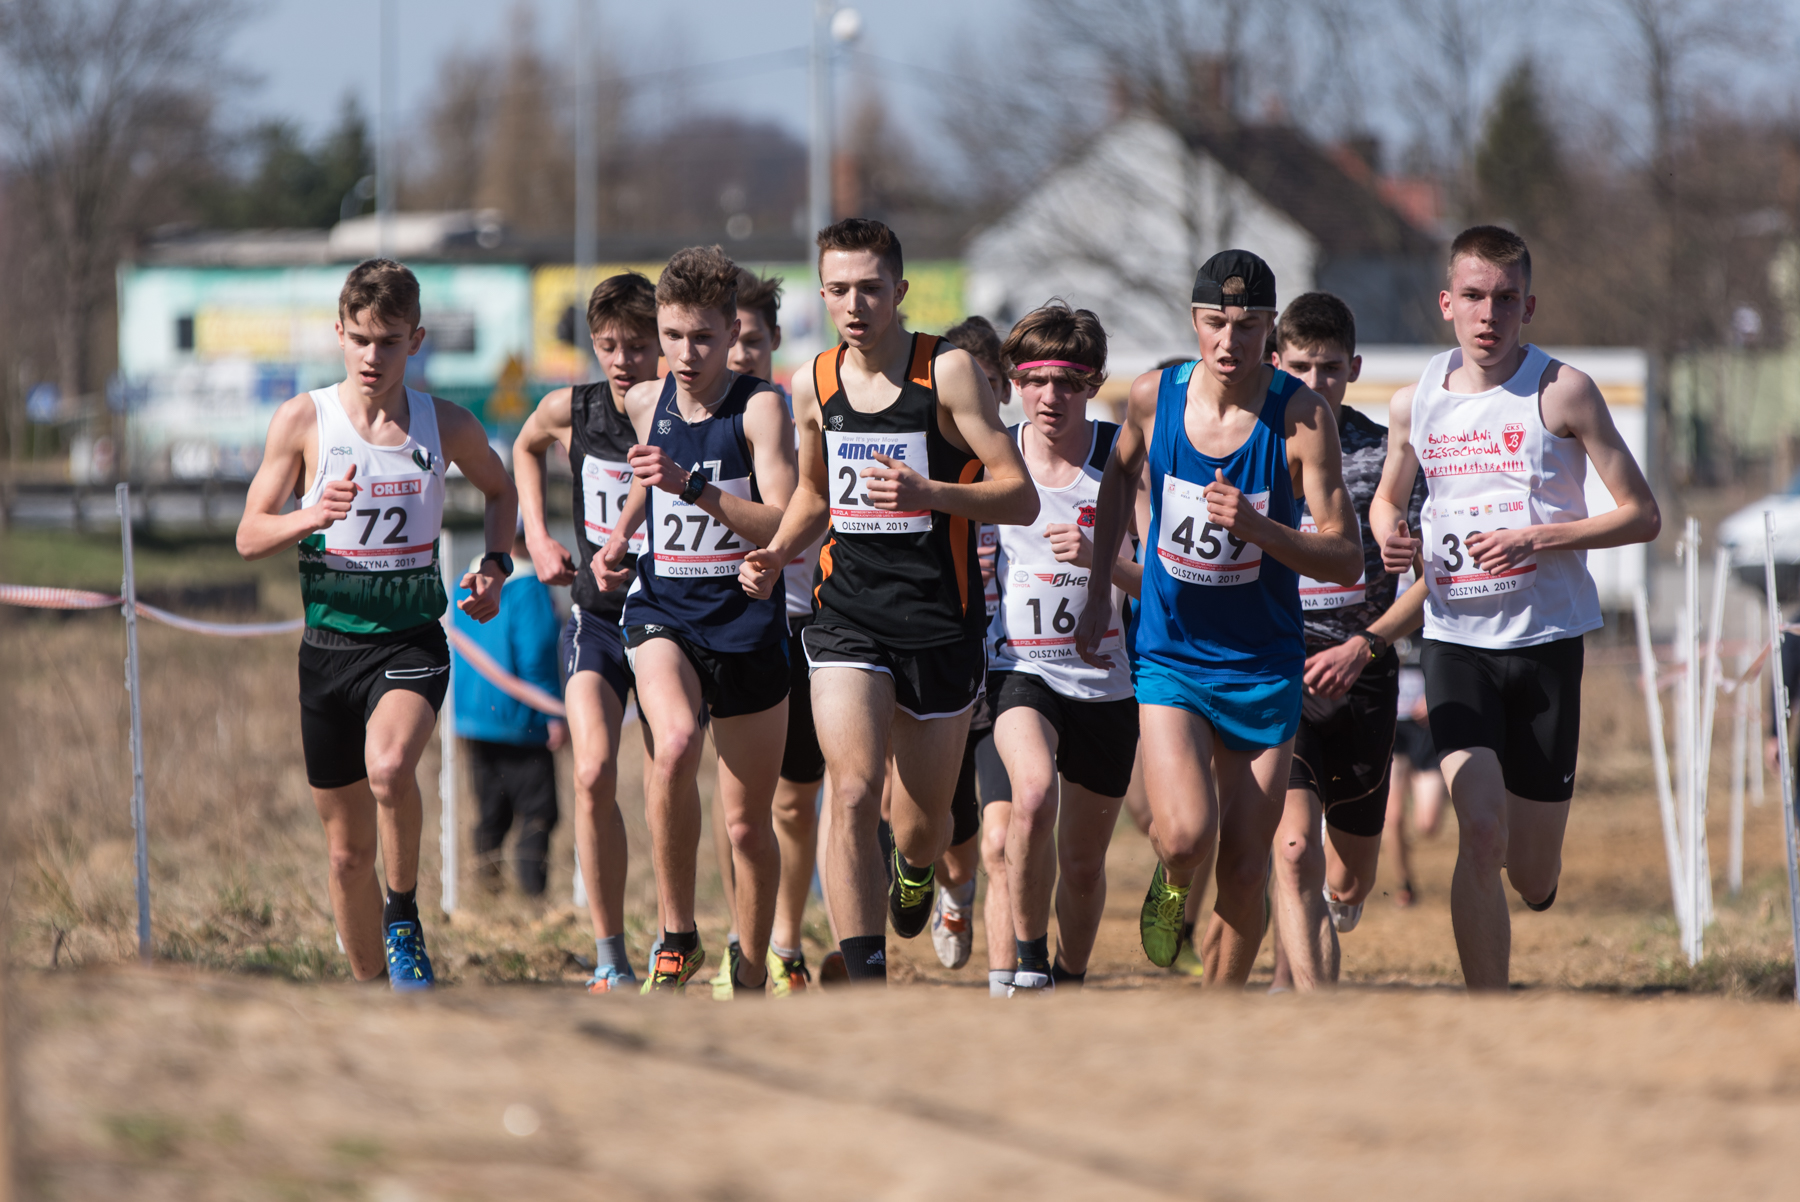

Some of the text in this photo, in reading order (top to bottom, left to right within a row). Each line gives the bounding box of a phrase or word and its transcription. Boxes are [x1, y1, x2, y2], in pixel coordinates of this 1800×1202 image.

[837, 443, 908, 460] 4MOVE
[374, 482, 419, 496] ORLEN
[1508, 501, 1523, 512] LUG
[356, 506, 409, 546] 72
[663, 513, 740, 552] 272
[842, 521, 909, 531] OLSZYNA 2019
[1171, 515, 1247, 561] 459
[345, 557, 416, 570] OLSZYNA 2019
[668, 564, 737, 575] OLSZYNA 2019
[1171, 566, 1241, 584] OLSZYNA 2019
[1449, 580, 1517, 597] OLSZYNA 2019
[1323, 596, 1345, 606] 2019
[1029, 648, 1073, 659] OLSZYNA
